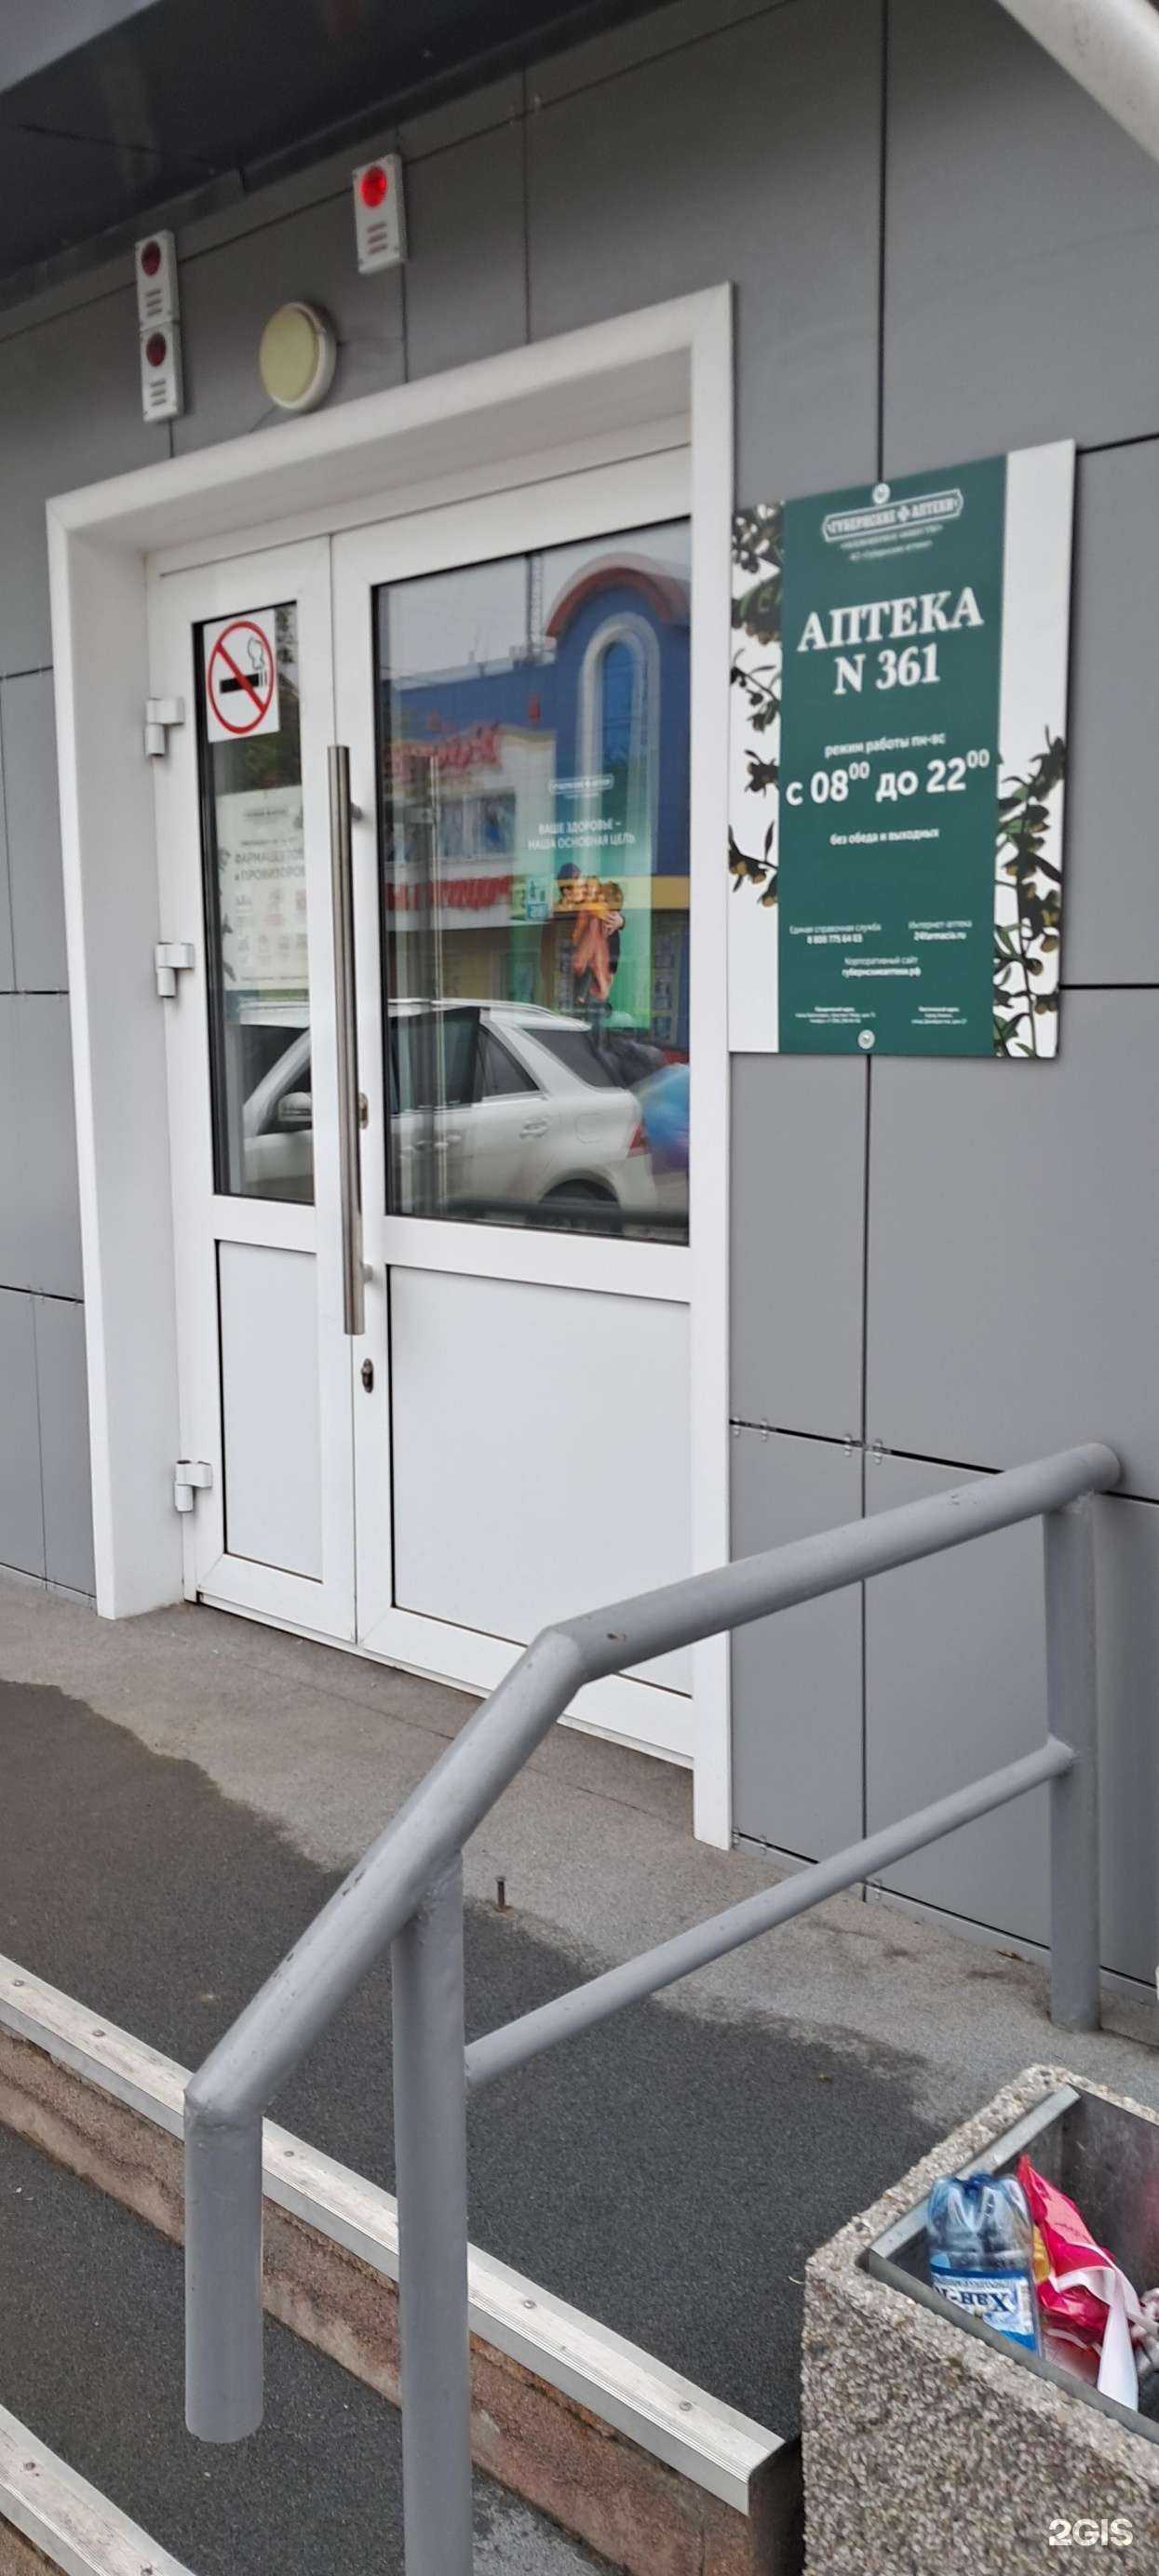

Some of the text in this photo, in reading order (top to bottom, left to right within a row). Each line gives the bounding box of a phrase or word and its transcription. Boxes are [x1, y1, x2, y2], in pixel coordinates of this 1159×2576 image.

[797, 586, 985, 652] АПТЕКА
[833, 642, 941, 695] N 361
[824, 731, 947, 759] режим работы пн-вс
[786, 781, 803, 806] с
[875, 771, 919, 803] до
[829, 827, 939, 846] без обеда и выходных
